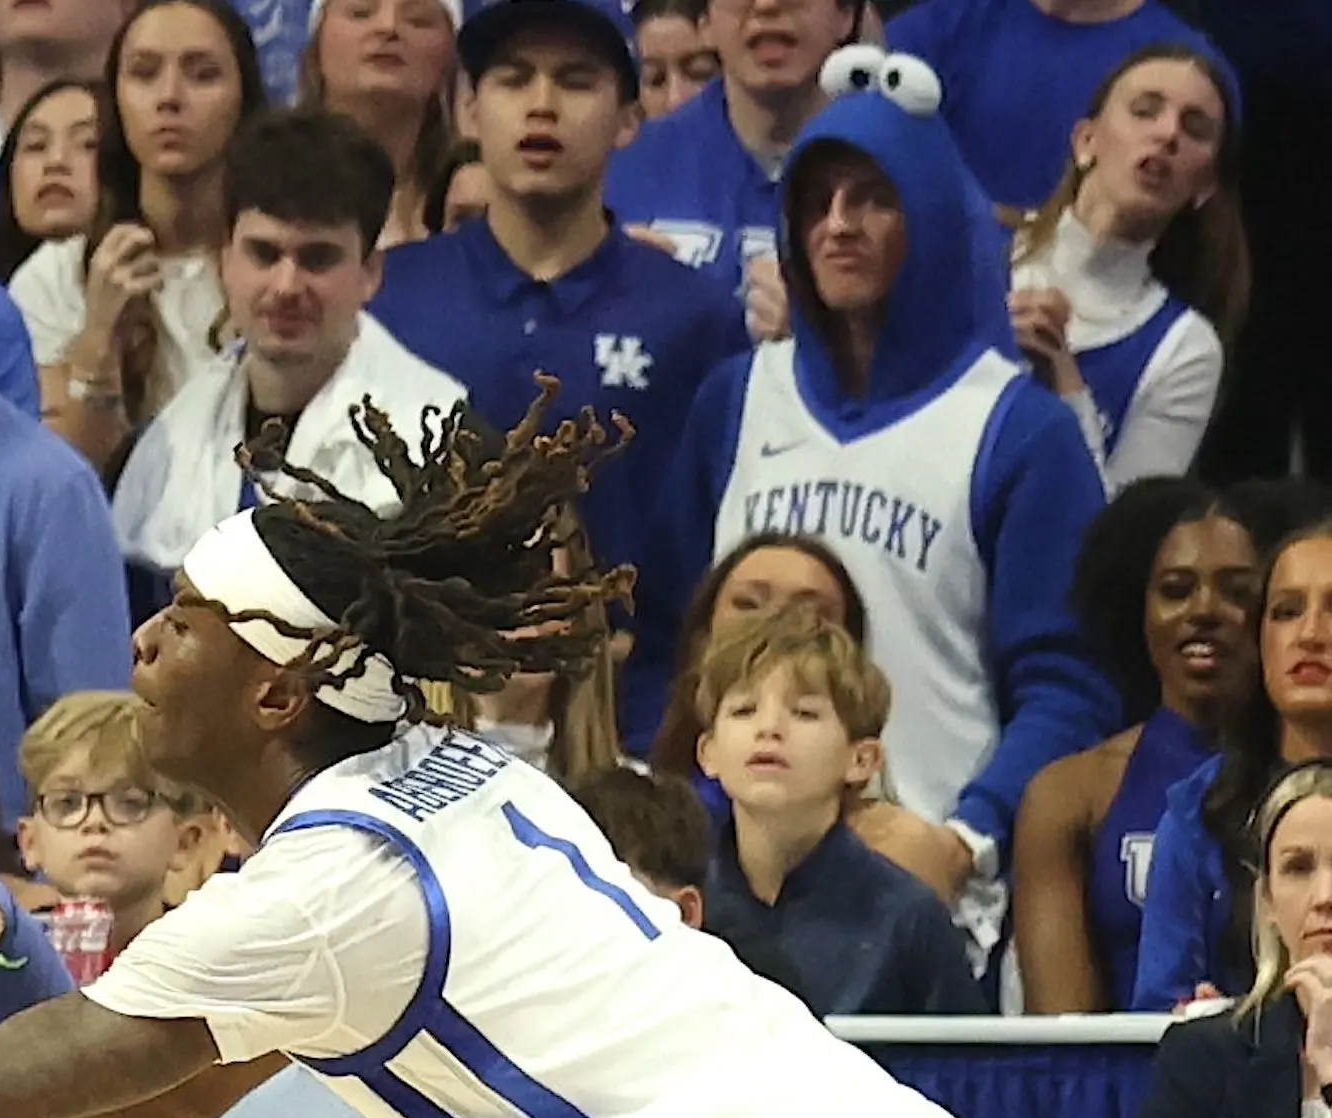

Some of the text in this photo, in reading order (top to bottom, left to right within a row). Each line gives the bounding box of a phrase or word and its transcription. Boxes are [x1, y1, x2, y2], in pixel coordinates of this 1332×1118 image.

[594, 333, 655, 390] UK
[742, 478, 943, 571] KENTUCKY
[366, 720, 511, 824] ABERDEE
[500, 800, 662, 941] 1
